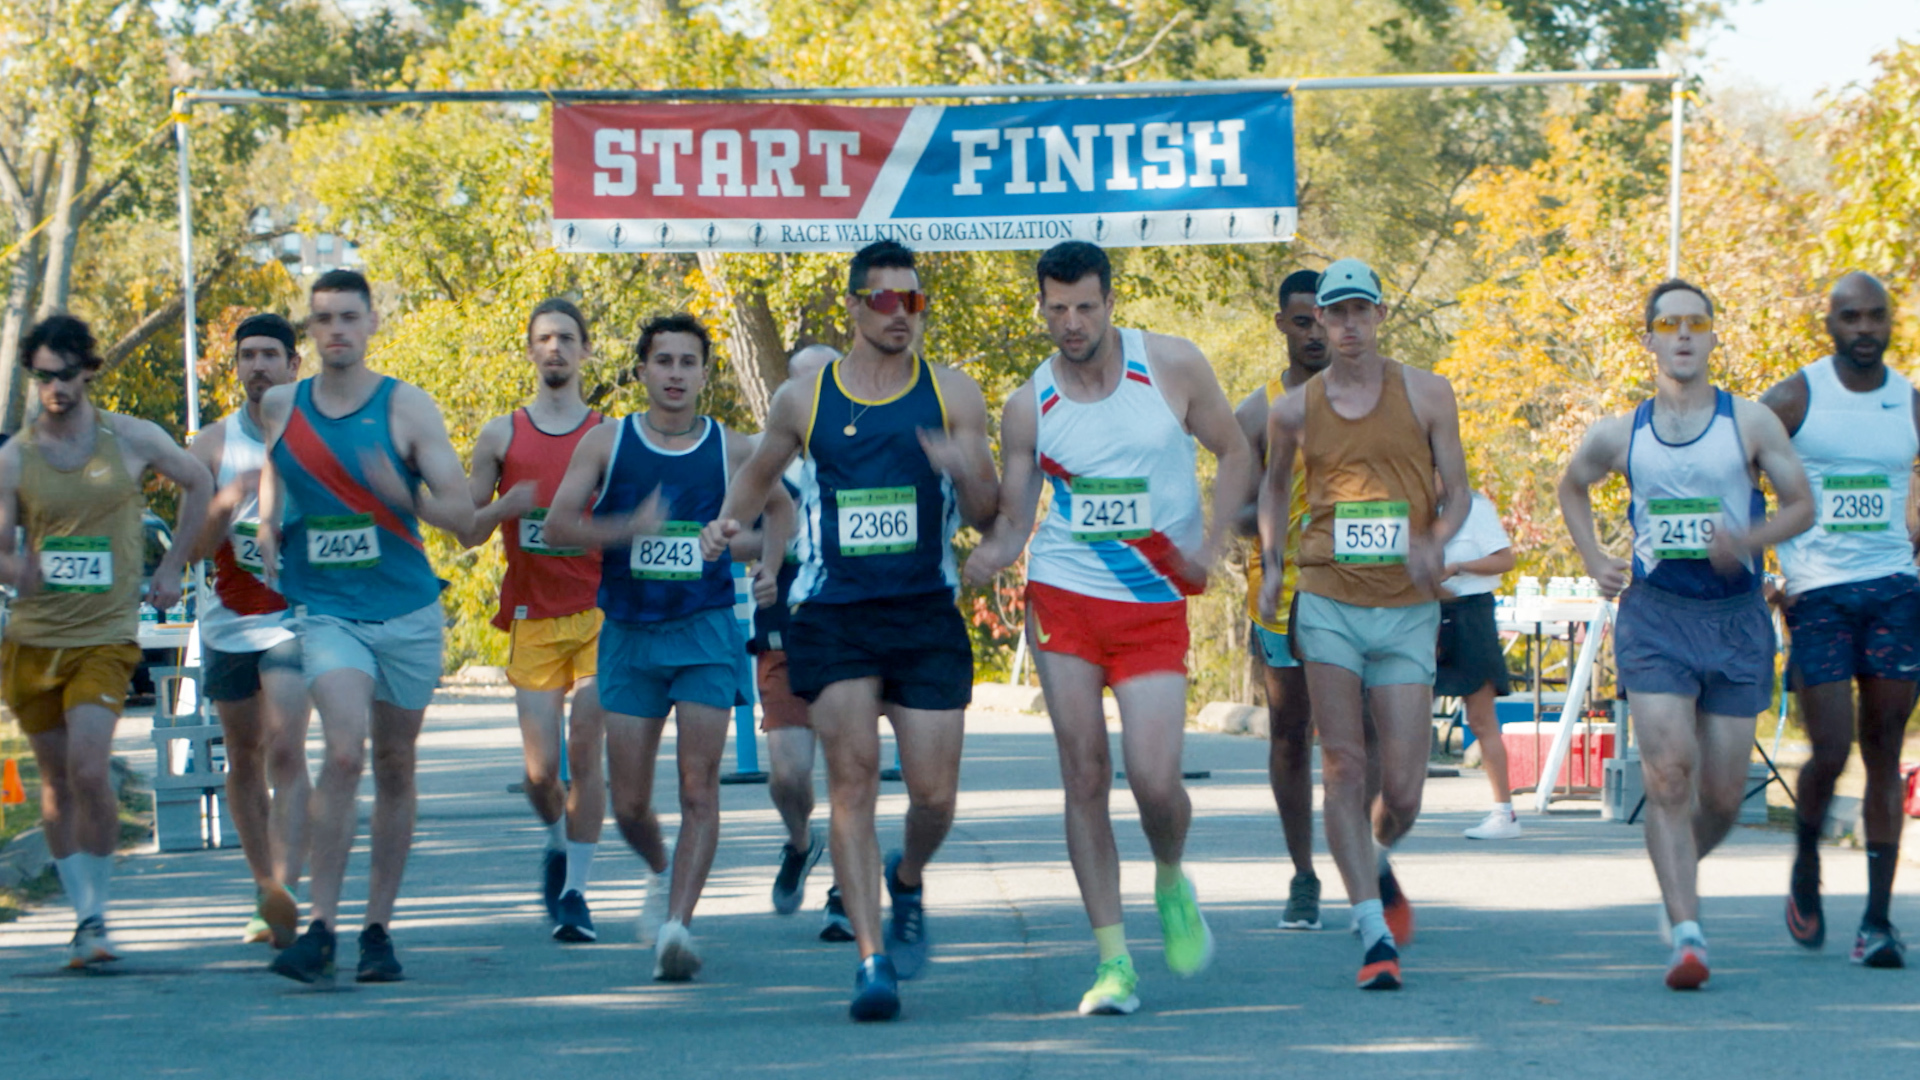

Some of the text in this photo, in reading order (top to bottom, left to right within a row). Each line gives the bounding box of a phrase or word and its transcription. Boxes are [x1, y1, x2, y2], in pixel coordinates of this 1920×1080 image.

[594, 119, 1248, 197] START FINISH
[781, 220, 1073, 243] RACE WALKING ORGANIZATION
[1082, 500, 1138, 526] 2421
[1832, 494, 1884, 518] 2389
[850, 509, 908, 539] 2366
[1346, 524, 1401, 549] 5537
[1658, 519, 1716, 544] 2419
[315, 533, 371, 558] 2404
[640, 540, 694, 566] 8243
[50, 556, 102, 579] 2374
